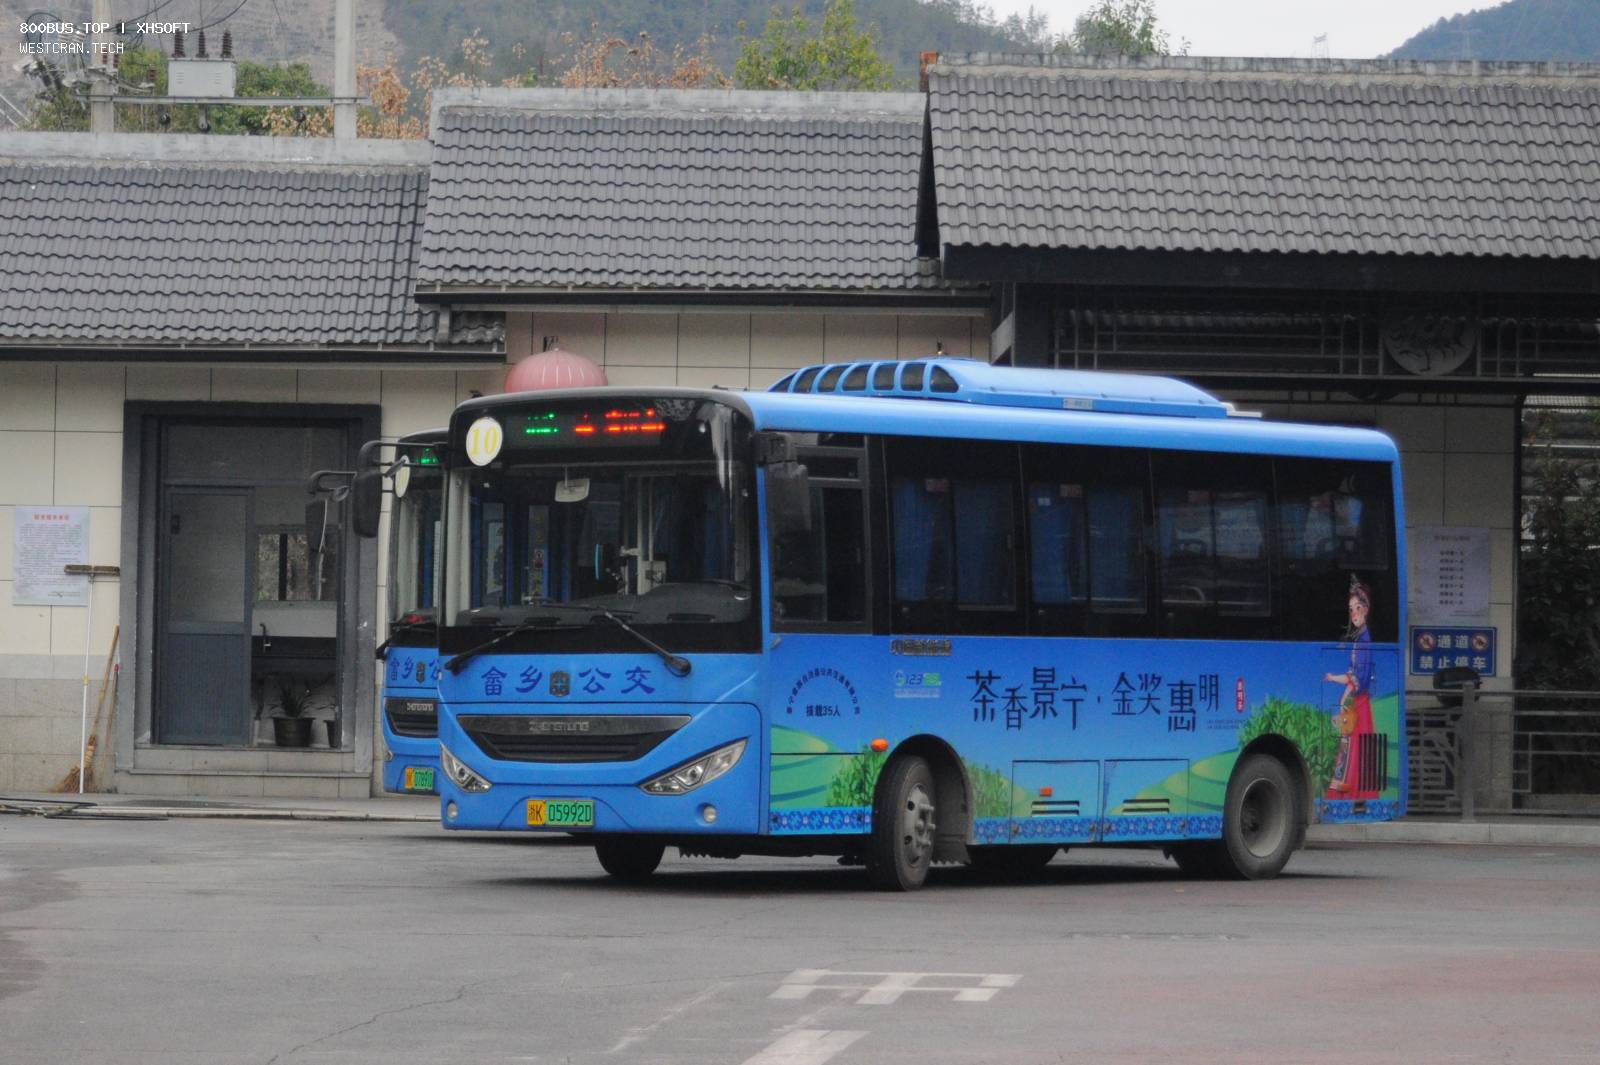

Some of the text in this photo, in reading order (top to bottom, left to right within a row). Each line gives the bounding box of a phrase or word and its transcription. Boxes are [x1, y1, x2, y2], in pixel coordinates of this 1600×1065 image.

[470, 428, 498, 457] 10
[1437, 634, 1469, 649] 通道
[1419, 655, 1487, 670] 禁止停车
[549, 805, 592, 822] 05992D
